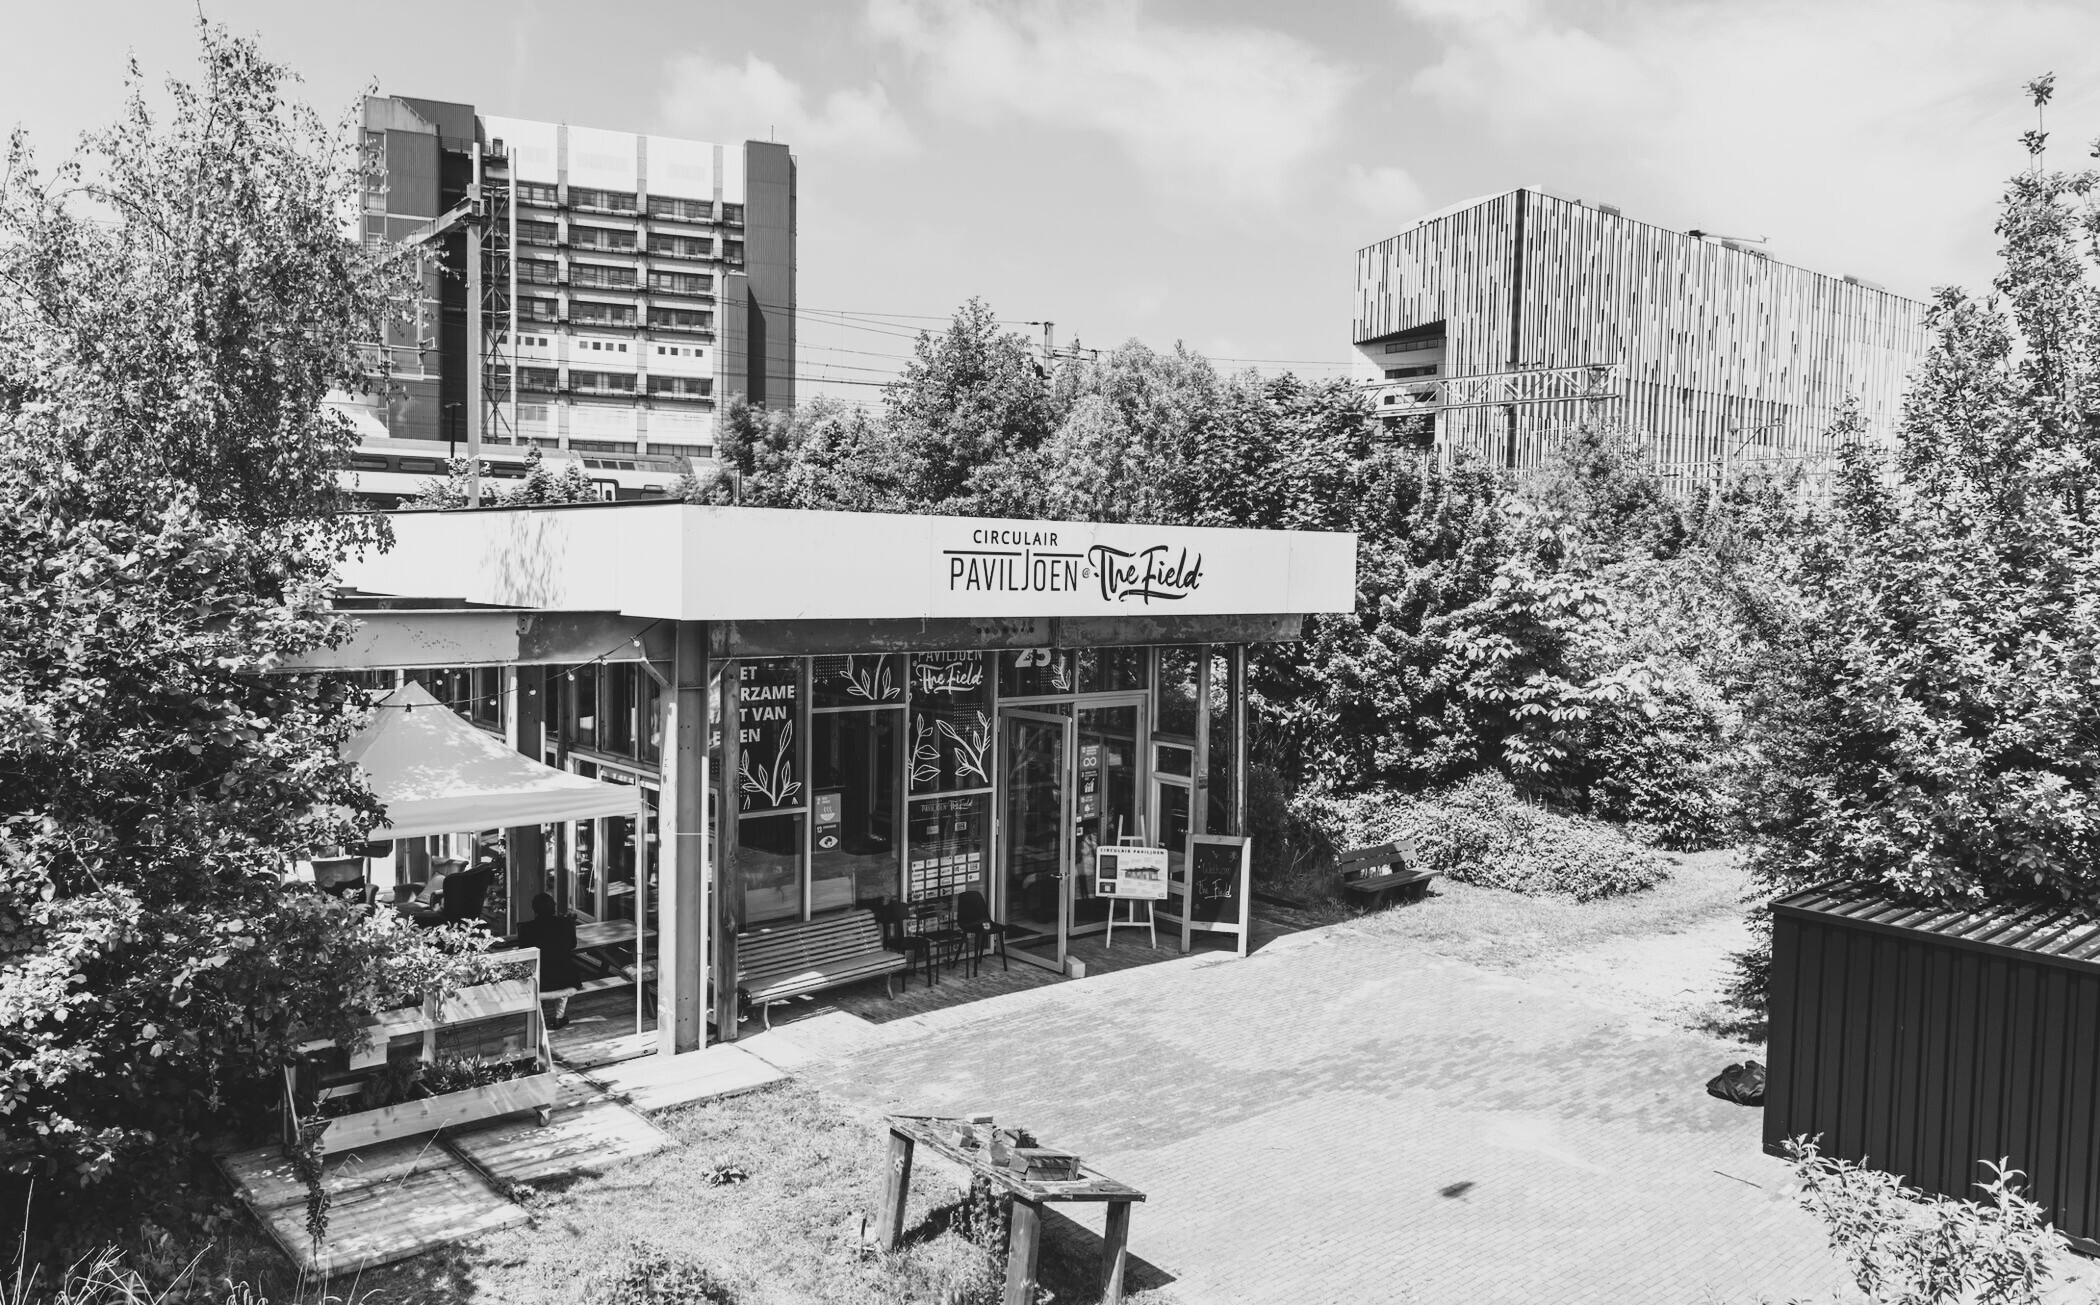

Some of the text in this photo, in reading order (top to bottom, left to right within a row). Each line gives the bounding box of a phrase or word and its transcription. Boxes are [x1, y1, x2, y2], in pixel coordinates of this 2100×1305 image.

[973, 529, 1058, 547] CIRCULAIR
[950, 545, 1204, 605] PAVILJOEN @ The Field
[740, 666, 757, 680] ET
[916, 662, 983, 695] The Field
[740, 685, 795, 701] RZAME
[752, 706, 787, 721] VAN
